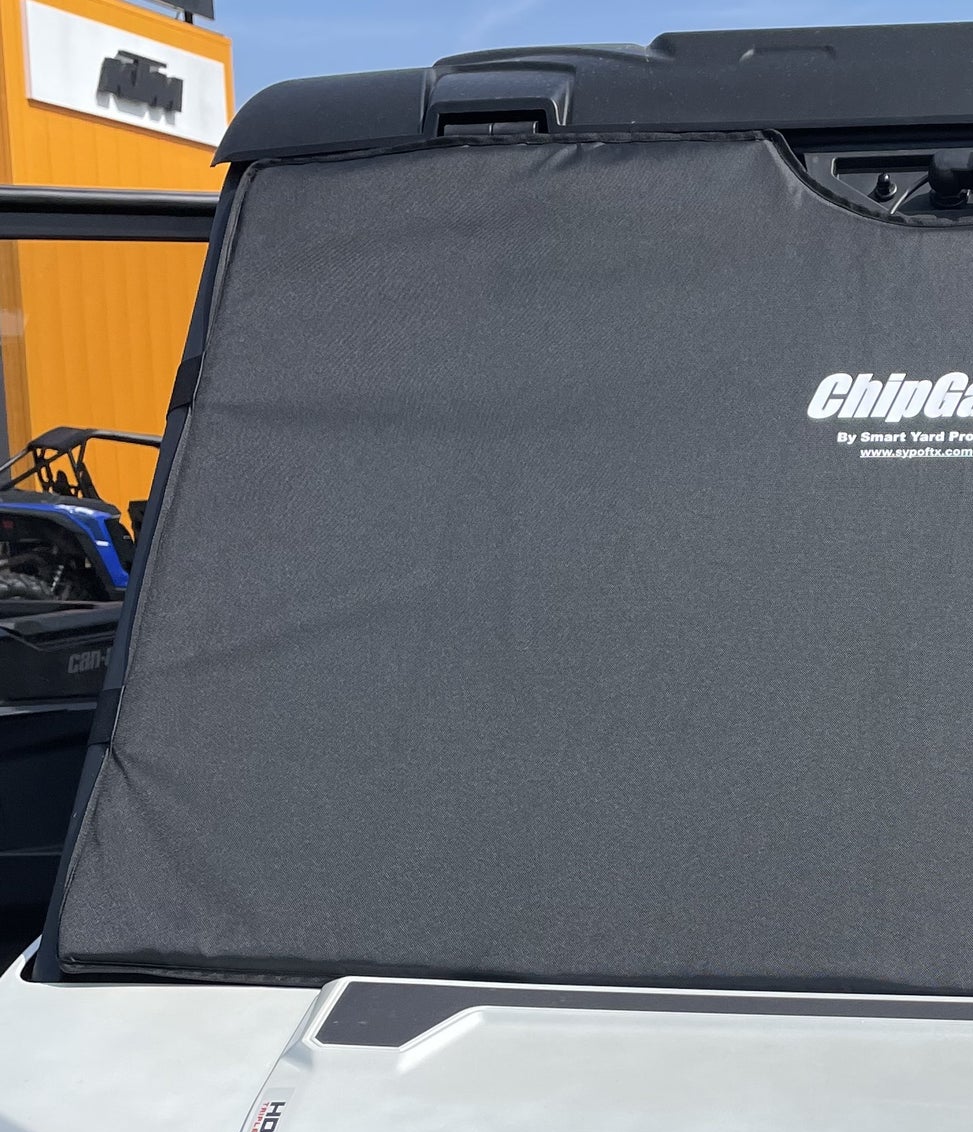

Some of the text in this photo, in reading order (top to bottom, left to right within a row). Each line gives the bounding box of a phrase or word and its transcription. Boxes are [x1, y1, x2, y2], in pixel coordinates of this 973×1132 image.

[837, 432, 857, 444] By
[860, 431, 906, 442] Smart
[911, 431, 945, 442] Yard
[860, 447, 973, 458] www.sypoftx.com
